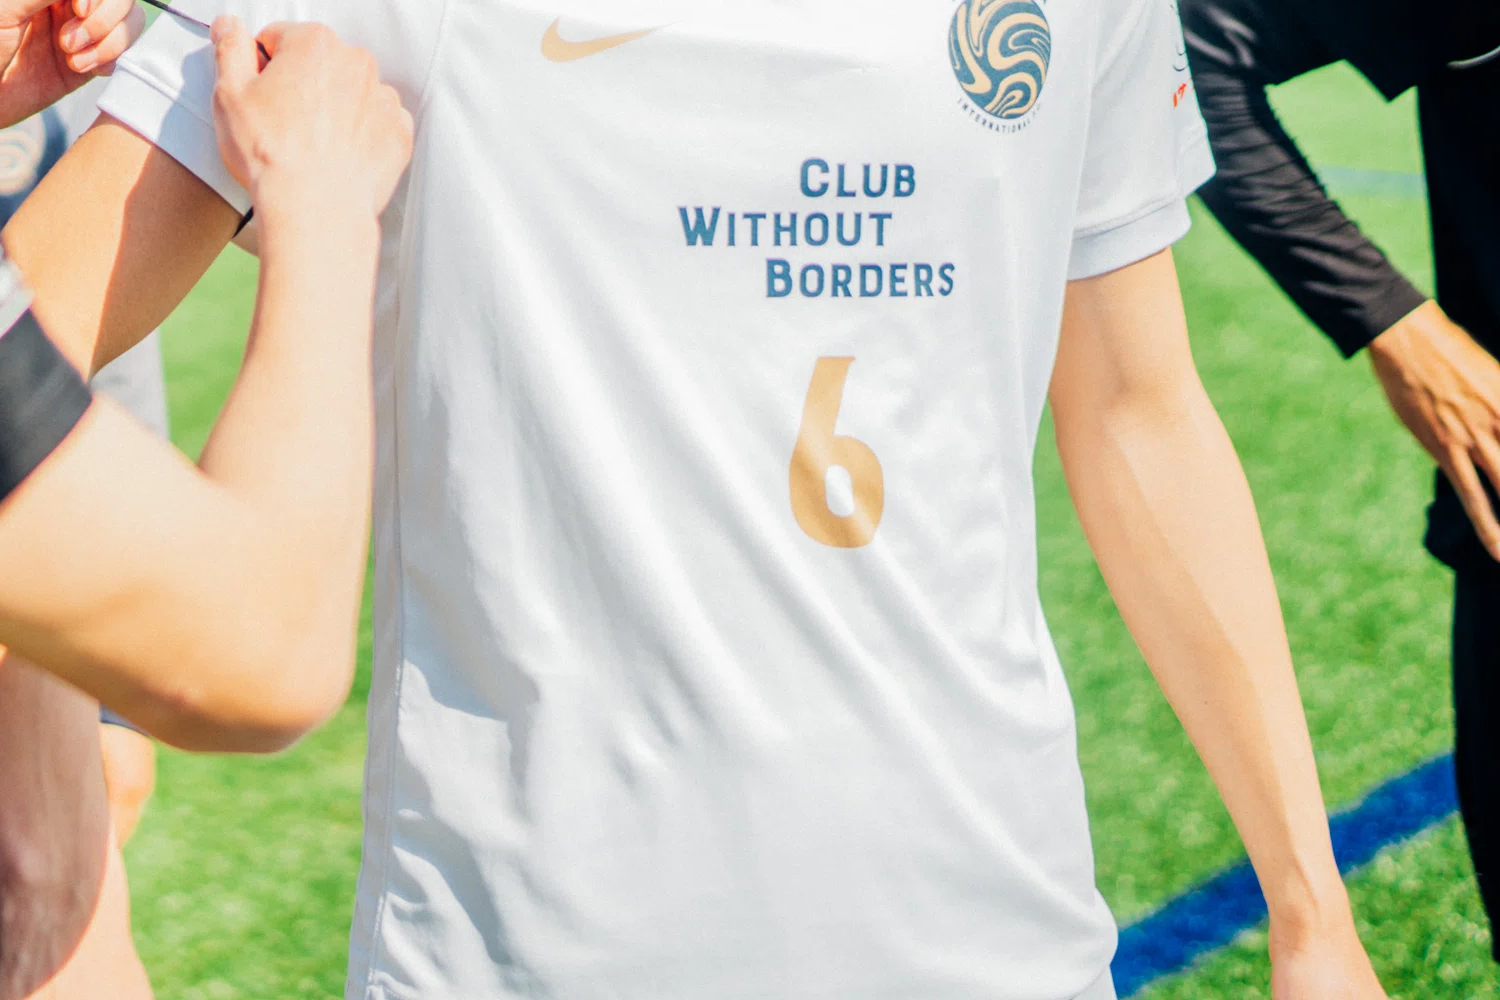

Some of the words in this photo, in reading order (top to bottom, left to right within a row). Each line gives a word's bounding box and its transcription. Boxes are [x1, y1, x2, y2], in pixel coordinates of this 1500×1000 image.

[956, 96, 1031, 134] INTERNATIONAL
[799, 157, 916, 198] CLUB
[677, 206, 893, 247] WITHOUT
[765, 257, 956, 298] BORDERS
[789, 356, 884, 548] 6
